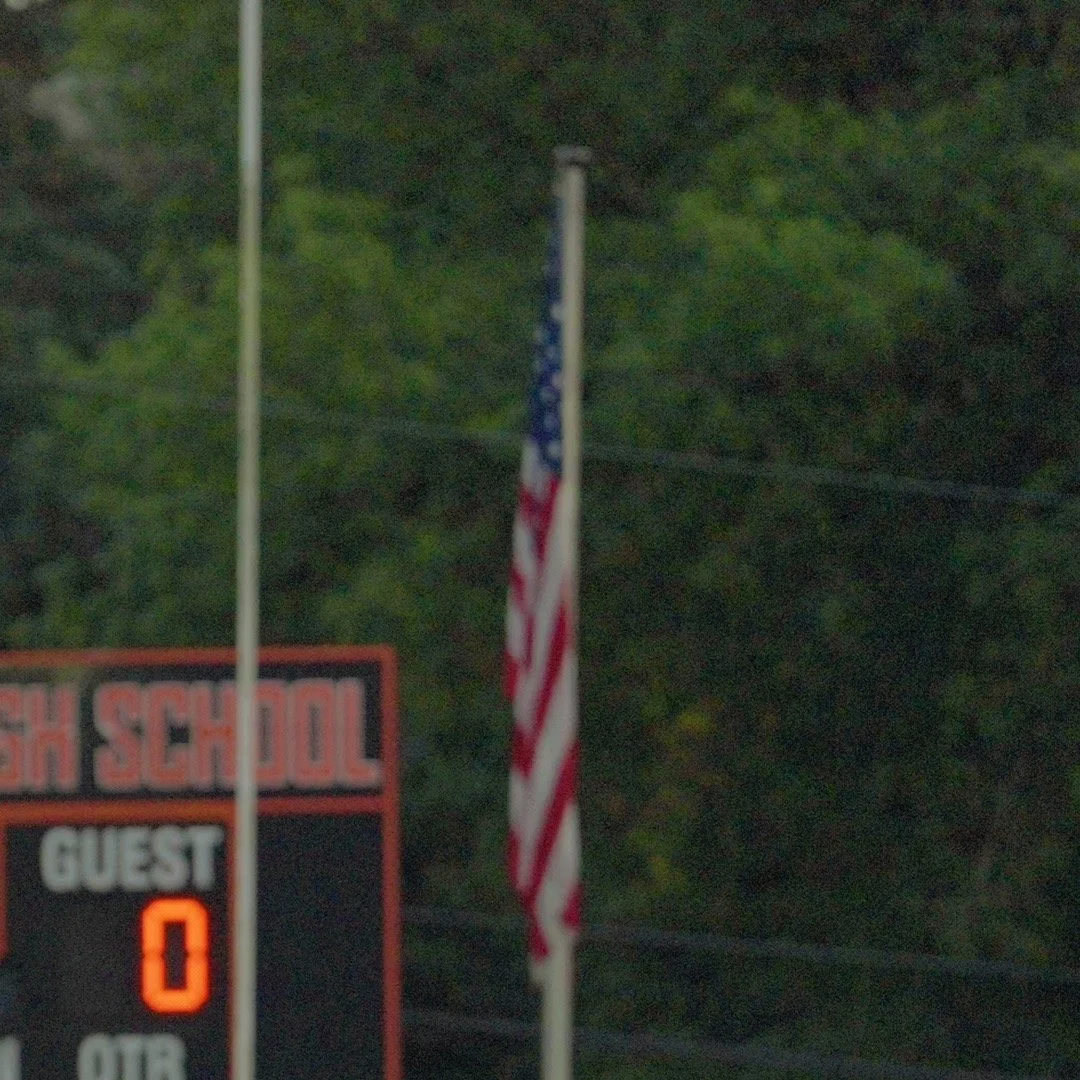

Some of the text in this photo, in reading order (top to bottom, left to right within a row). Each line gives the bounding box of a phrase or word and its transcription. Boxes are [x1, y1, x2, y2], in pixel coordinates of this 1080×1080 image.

[95, 678, 381, 791] SCHOOL
[40, 825, 222, 893] GUEST
[140, 898, 210, 1014] 0
